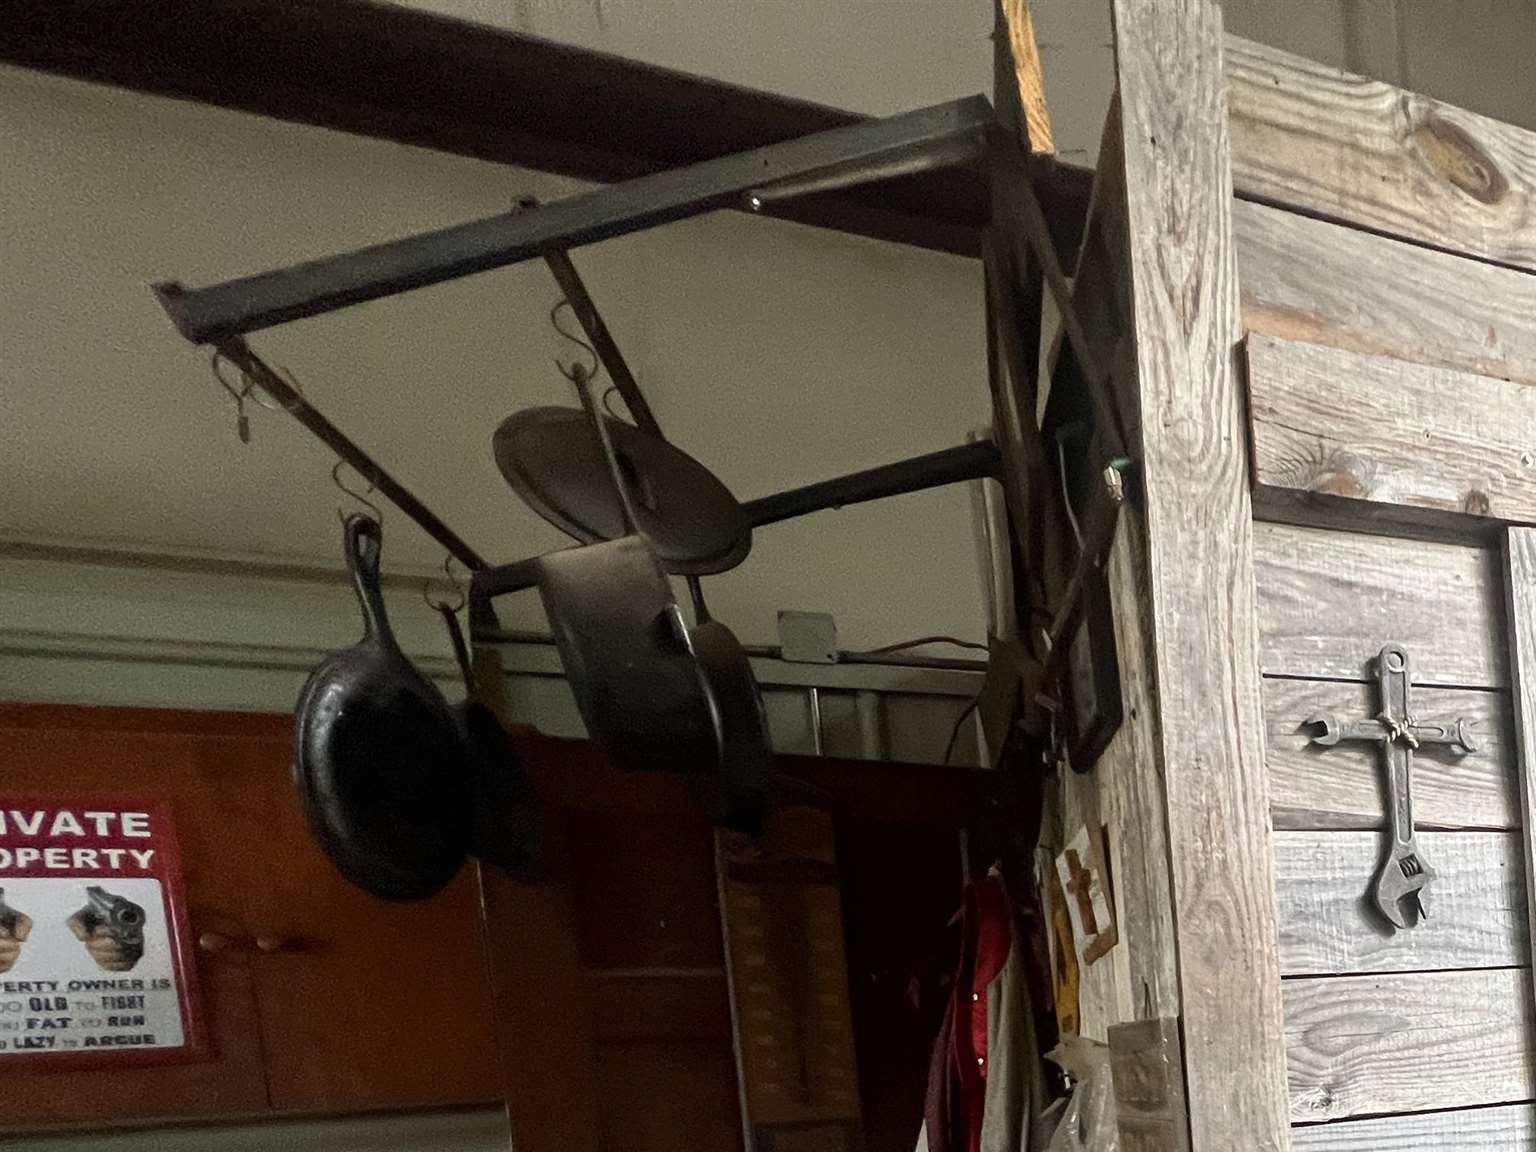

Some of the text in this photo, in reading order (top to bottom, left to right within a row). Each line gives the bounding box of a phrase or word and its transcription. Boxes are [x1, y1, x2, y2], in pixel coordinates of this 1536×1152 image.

[68, 980, 144, 991] OWNER
[151, 979, 170, 990] IS
[29, 996, 68, 1012] OLD
[26, 1017, 72, 1029] FAT
[14, 1035, 55, 1049] LAZY
[84, 1034, 156, 1047] ARGUE
